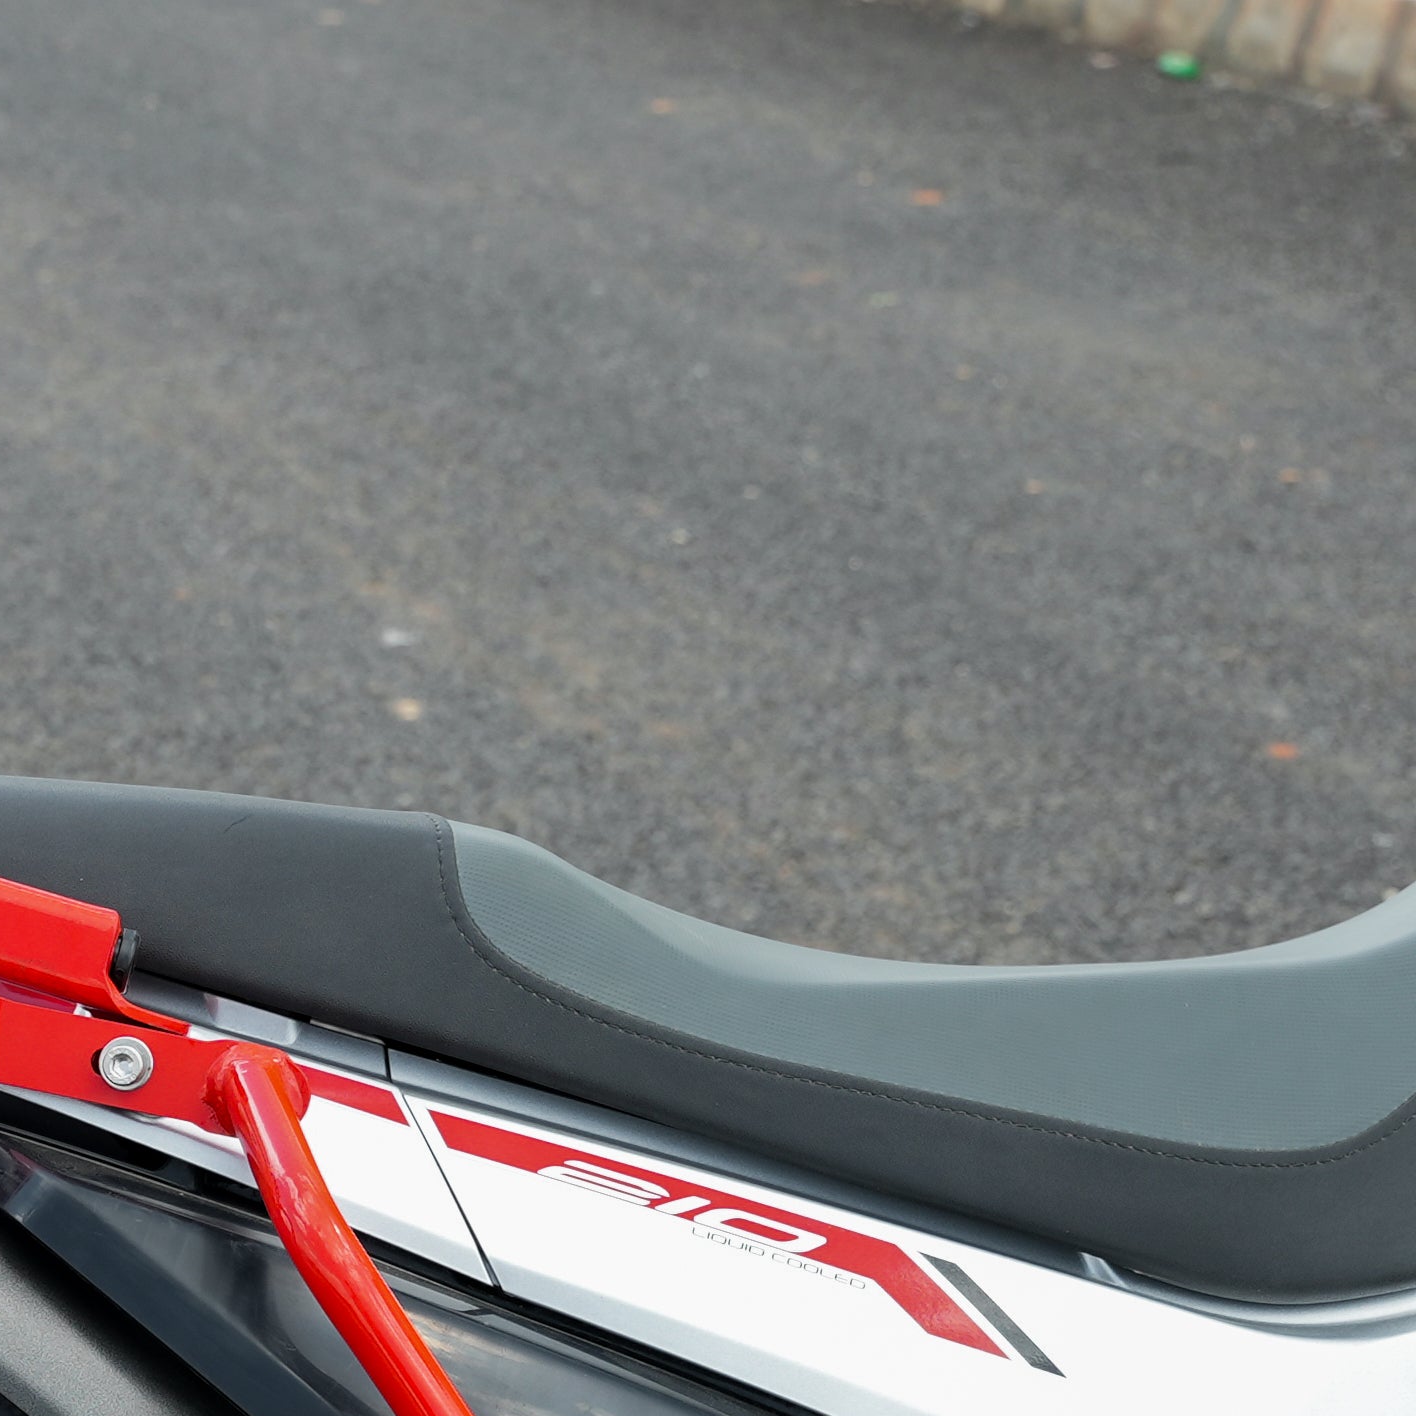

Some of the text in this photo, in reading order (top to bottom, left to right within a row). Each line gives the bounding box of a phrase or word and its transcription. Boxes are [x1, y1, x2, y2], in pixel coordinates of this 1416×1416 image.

[537, 1159, 827, 1254] 210
[692, 1227, 866, 1290] LIQUID COOLED
